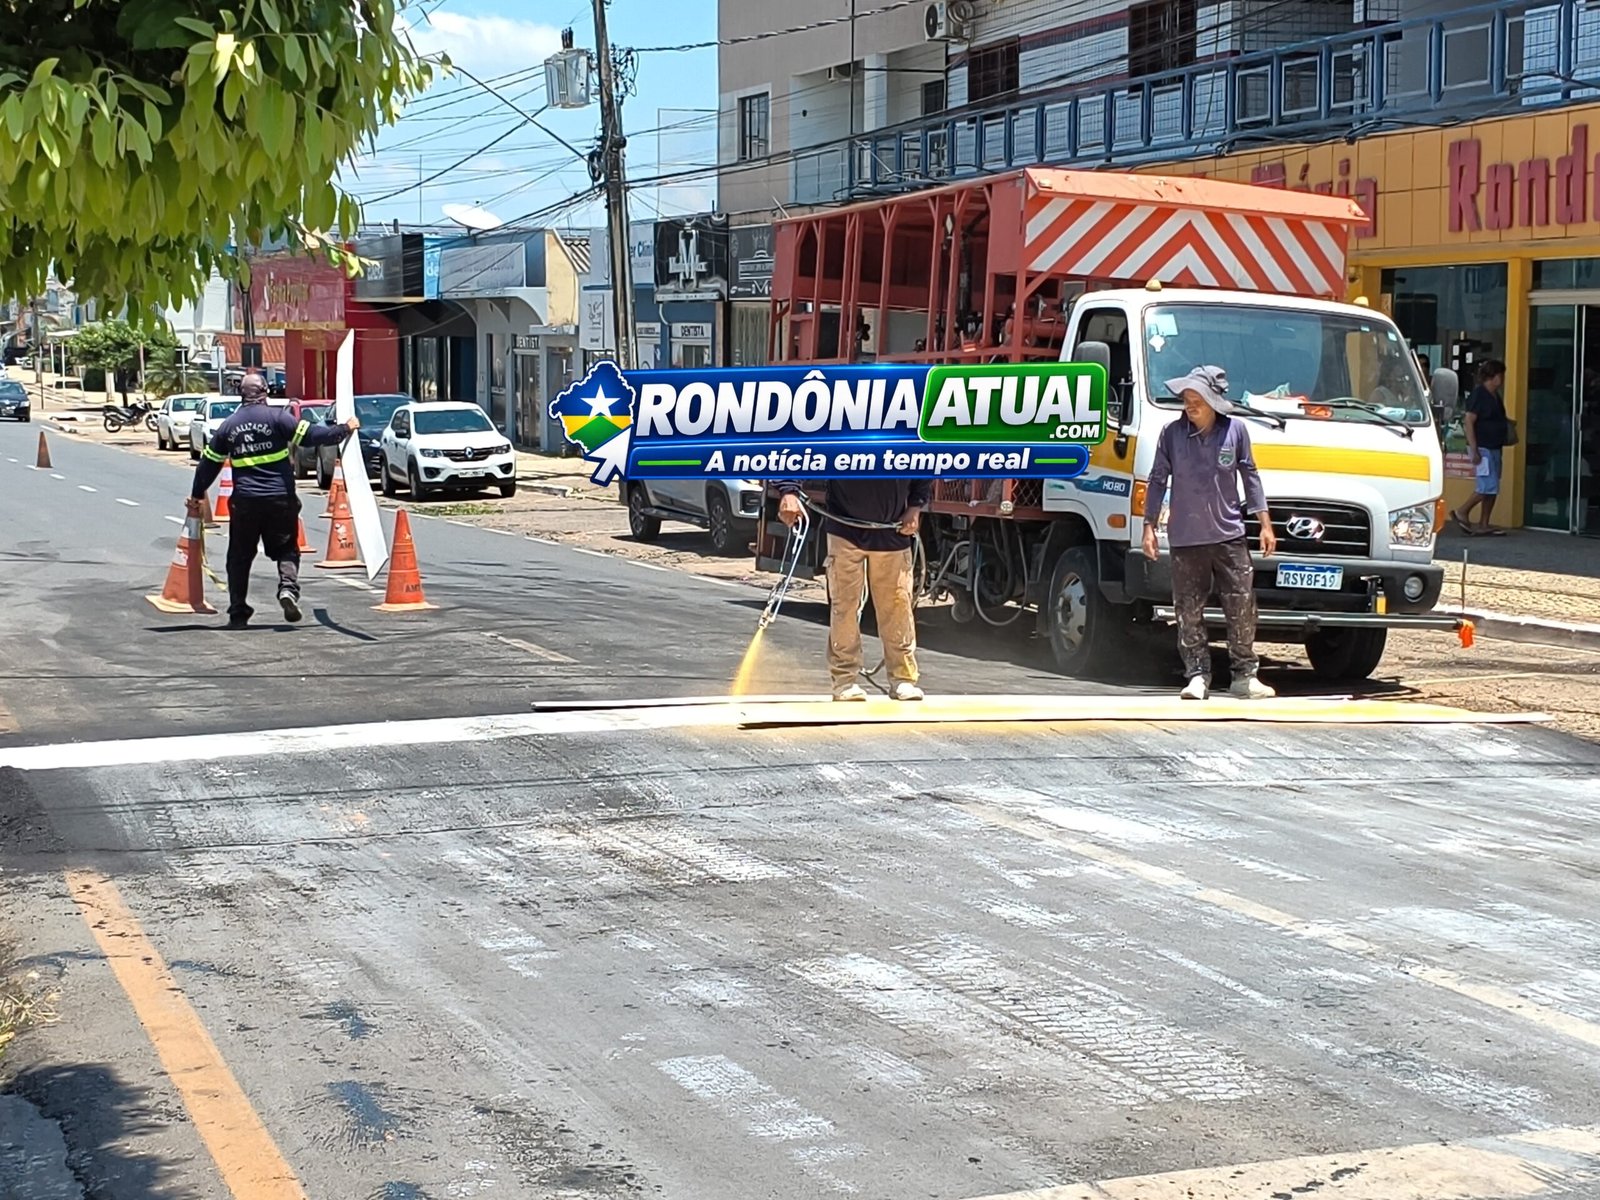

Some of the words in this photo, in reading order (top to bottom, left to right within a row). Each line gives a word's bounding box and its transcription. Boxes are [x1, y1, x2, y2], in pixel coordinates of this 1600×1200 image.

[1448, 123, 1600, 232] Rond
[680, 325, 704, 337] DENTISTA
[516, 336, 540, 349] DENTIST
[1282, 571, 1336, 588] RSY8F19
